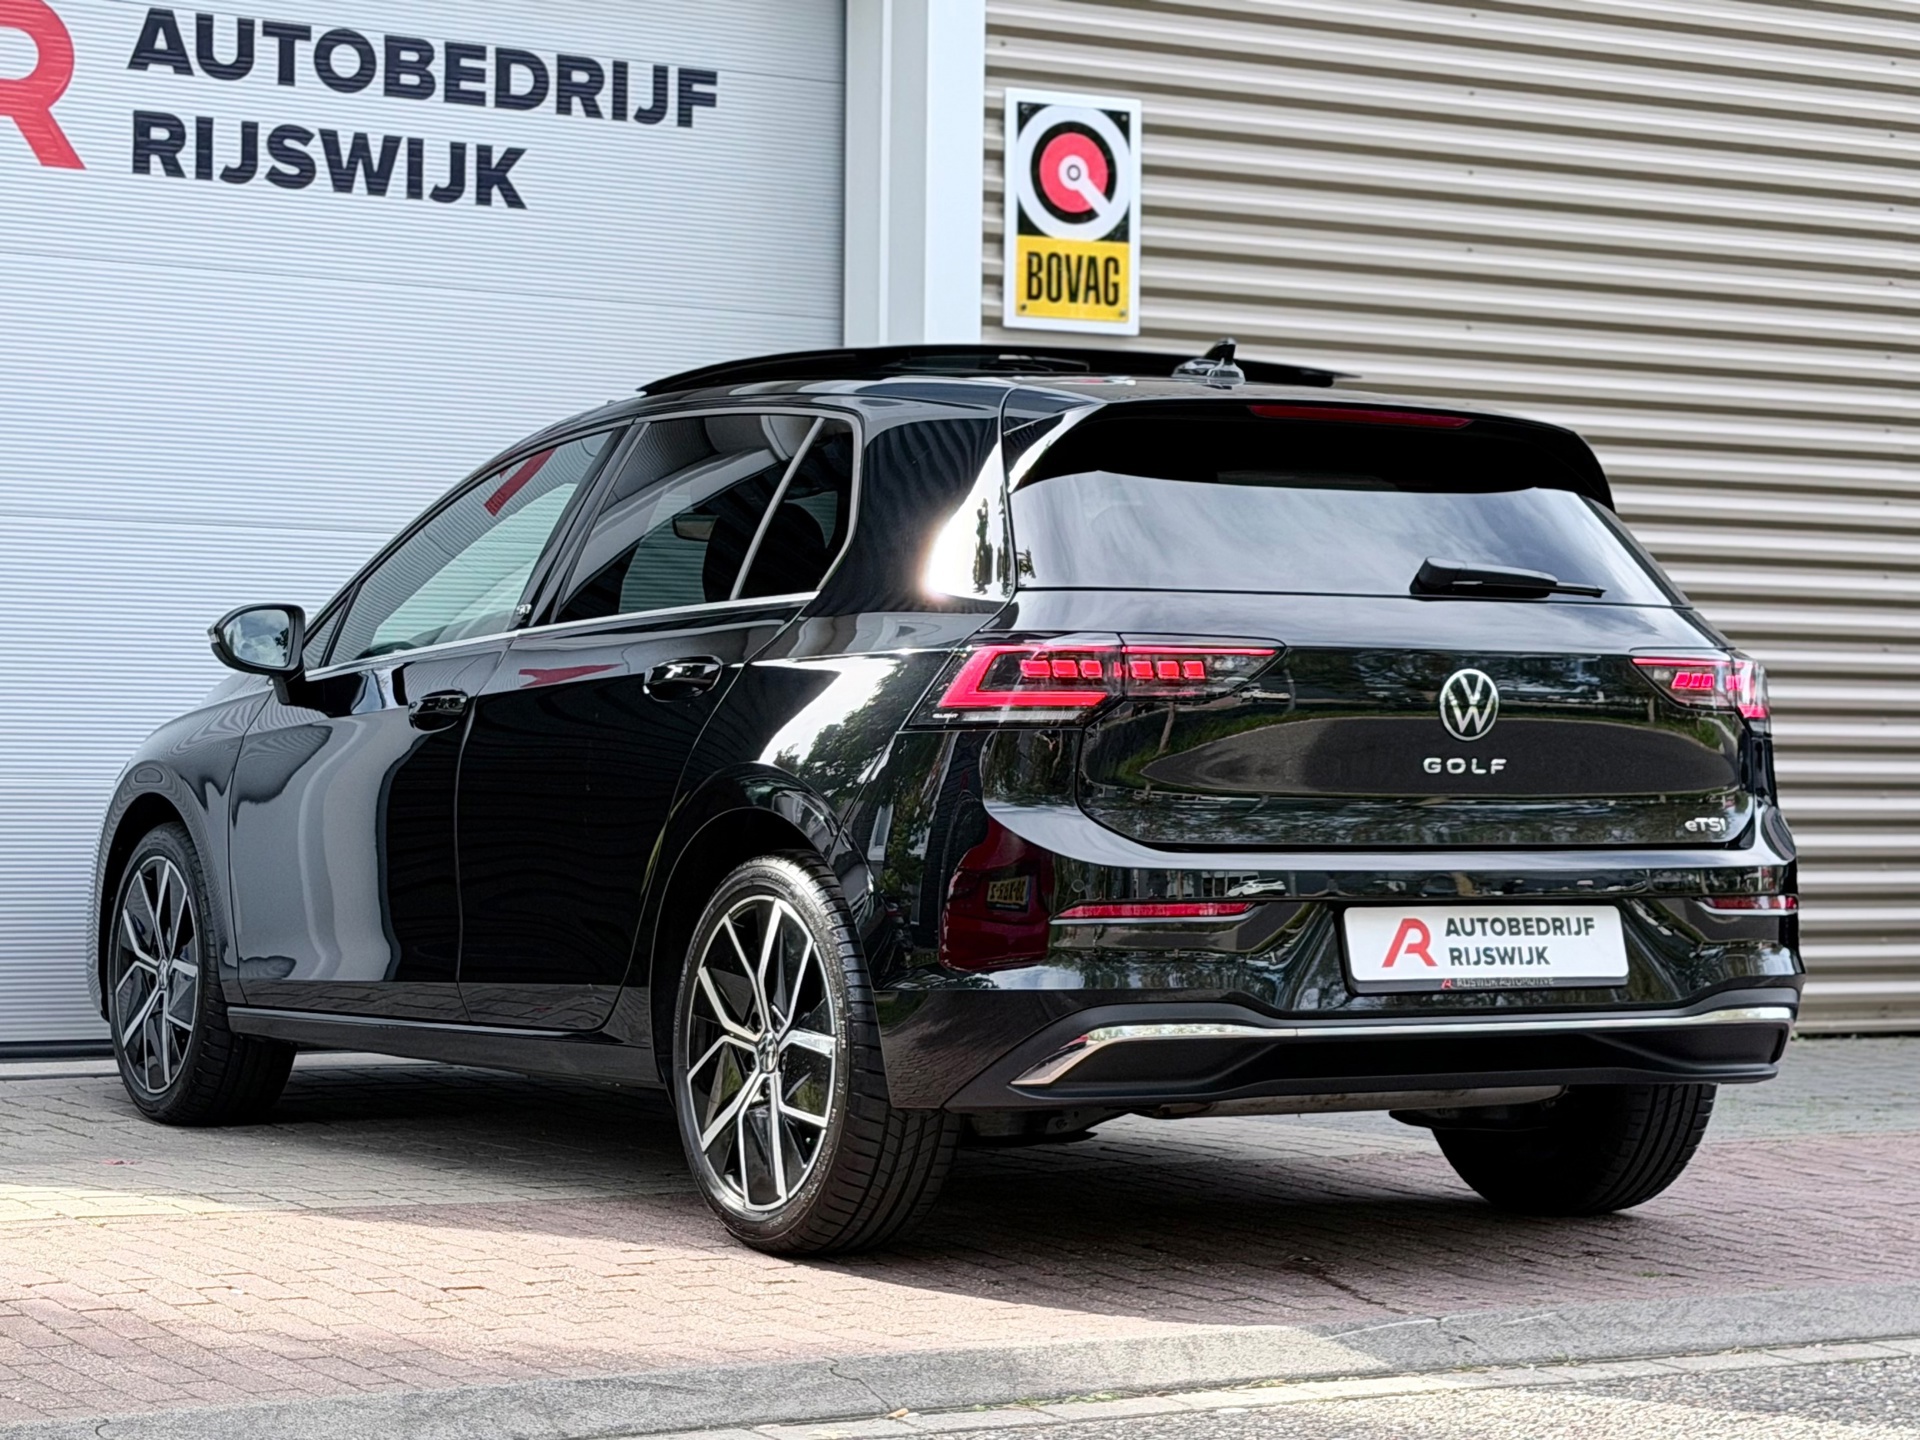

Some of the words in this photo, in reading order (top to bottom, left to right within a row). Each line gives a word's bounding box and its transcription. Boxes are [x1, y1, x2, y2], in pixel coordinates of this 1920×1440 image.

[128, 7, 718, 128] AUTOBEDRIJF
[131, 109, 528, 209] RIJSWIJK
[1026, 251, 1120, 306] BOVAG
[1423, 757, 1507, 774] GOLF
[1445, 916, 1595, 937] AUTOBEDRIJF
[1448, 946, 1550, 966] RIJSWIJK
